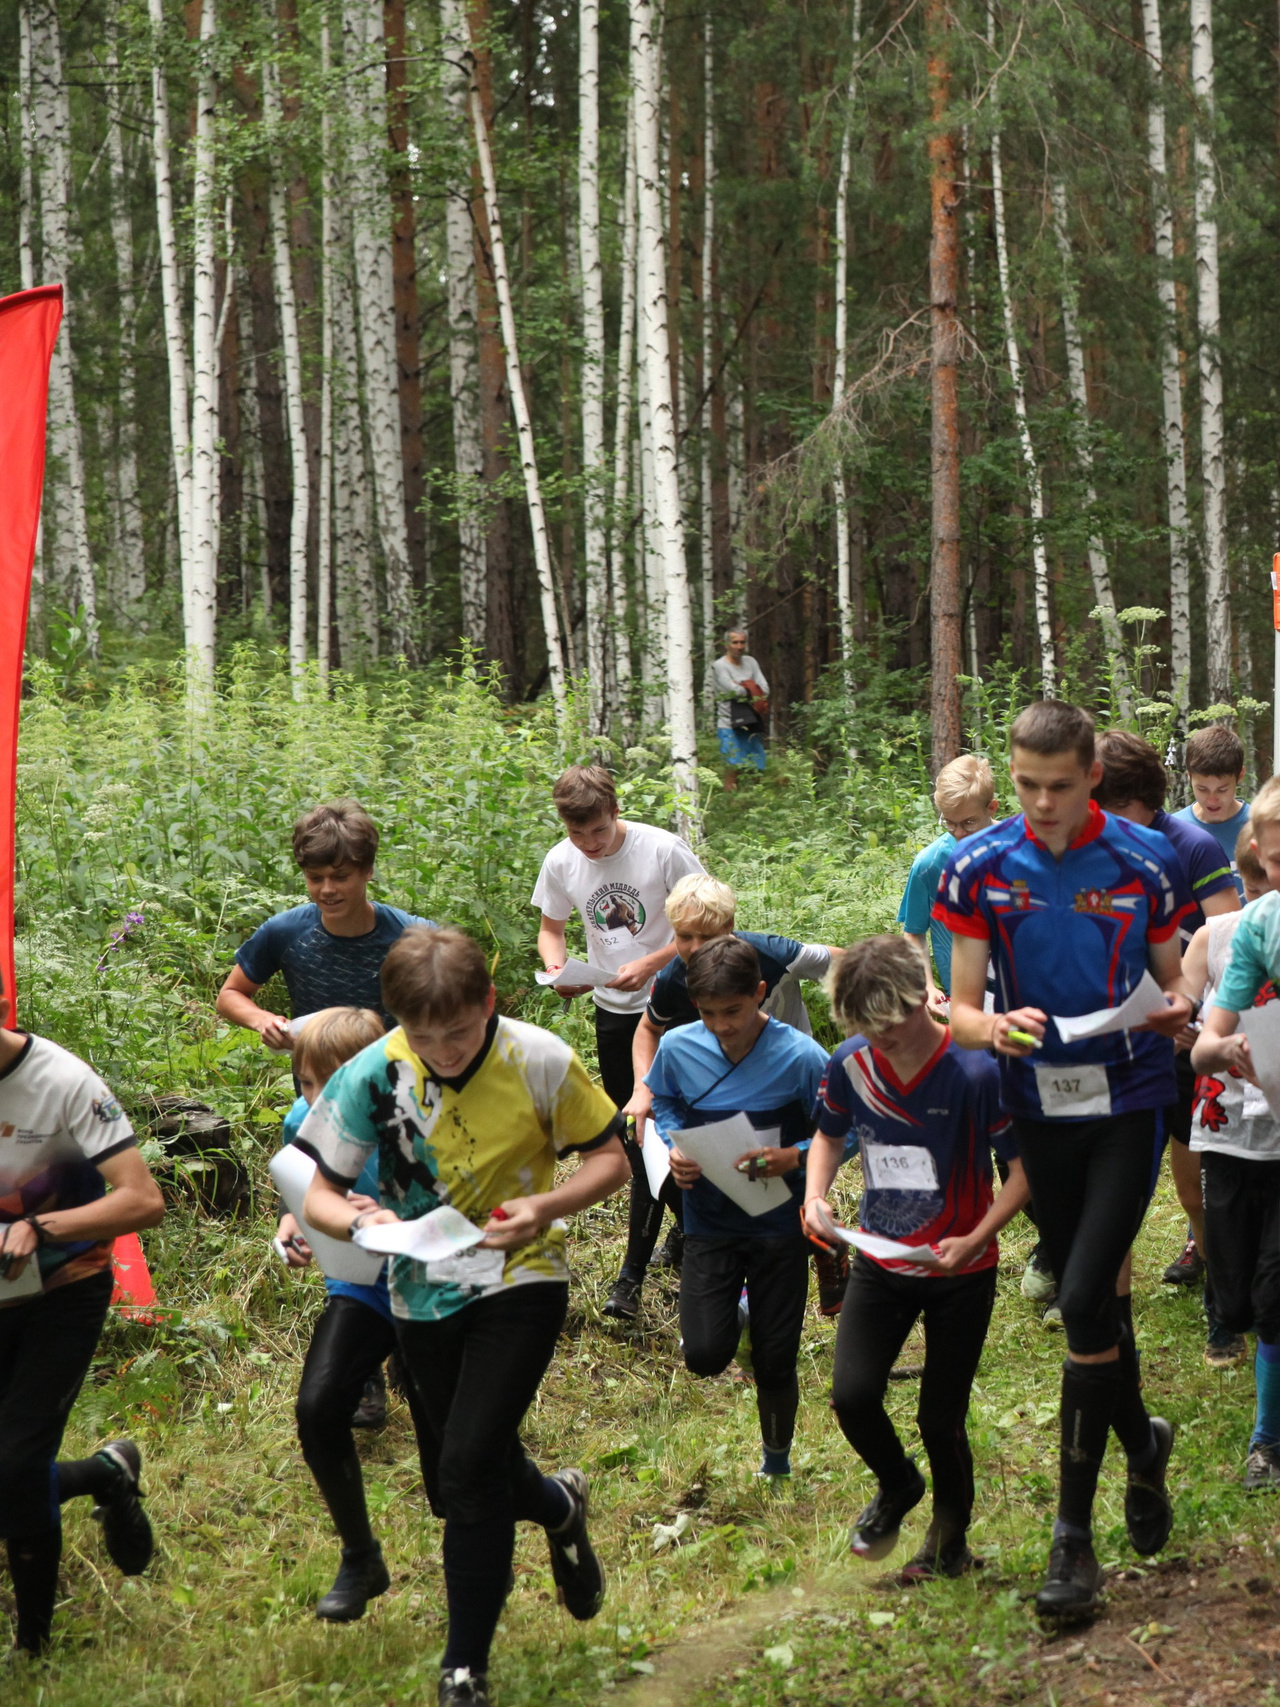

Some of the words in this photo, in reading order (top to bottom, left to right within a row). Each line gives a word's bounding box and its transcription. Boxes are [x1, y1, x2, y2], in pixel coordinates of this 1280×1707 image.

[600, 936, 619, 946] 152
[1052, 1079, 1081, 1093] 137
[881, 1156, 910, 1169] 136
